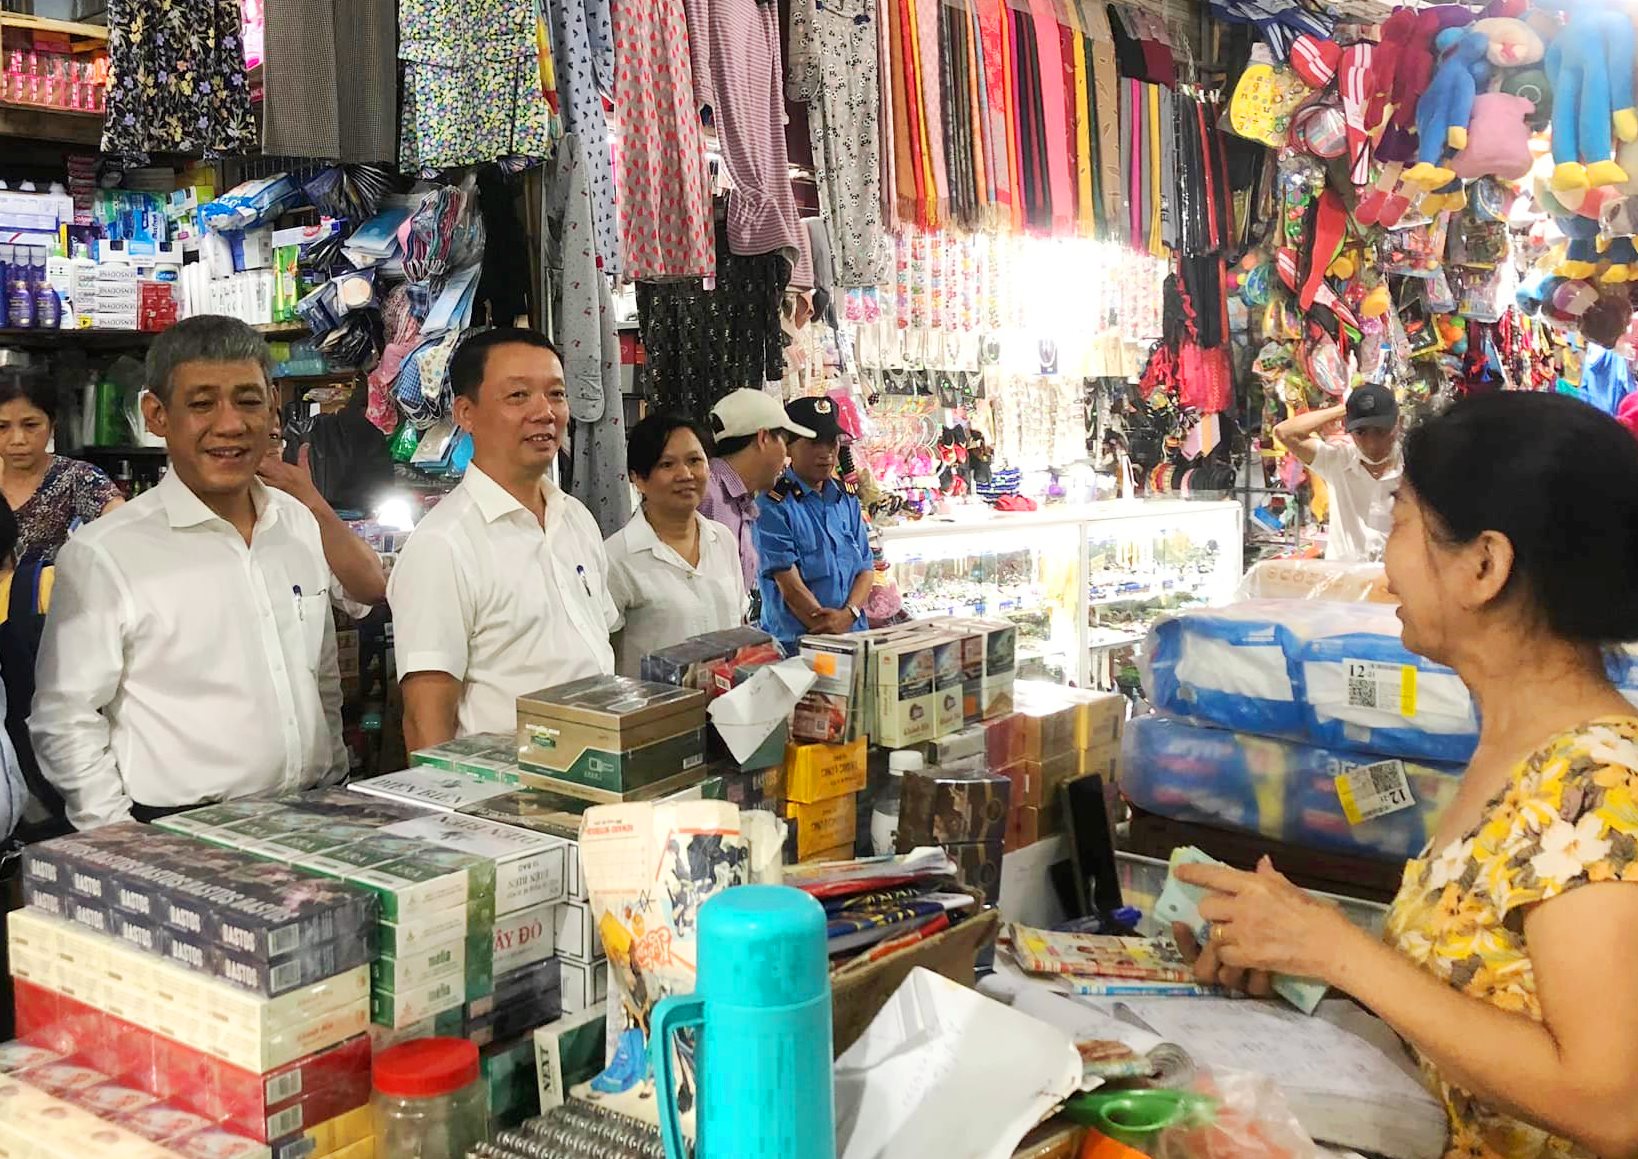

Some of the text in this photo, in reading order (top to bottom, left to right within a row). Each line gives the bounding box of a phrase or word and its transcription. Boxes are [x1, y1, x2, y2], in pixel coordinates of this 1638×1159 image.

[74, 872, 102, 897] BASTOS
[120, 888, 150, 915] BASTOS
[169, 904, 200, 933] BASTOS
[122, 921, 153, 948] BASTOS
[222, 923, 256, 952] BASTOS
[493, 927, 513, 952] ÂY
[172, 939, 203, 968] BASTOS
[224, 958, 258, 988] BASTOS
[540, 1044, 552, 1092] NEXT
